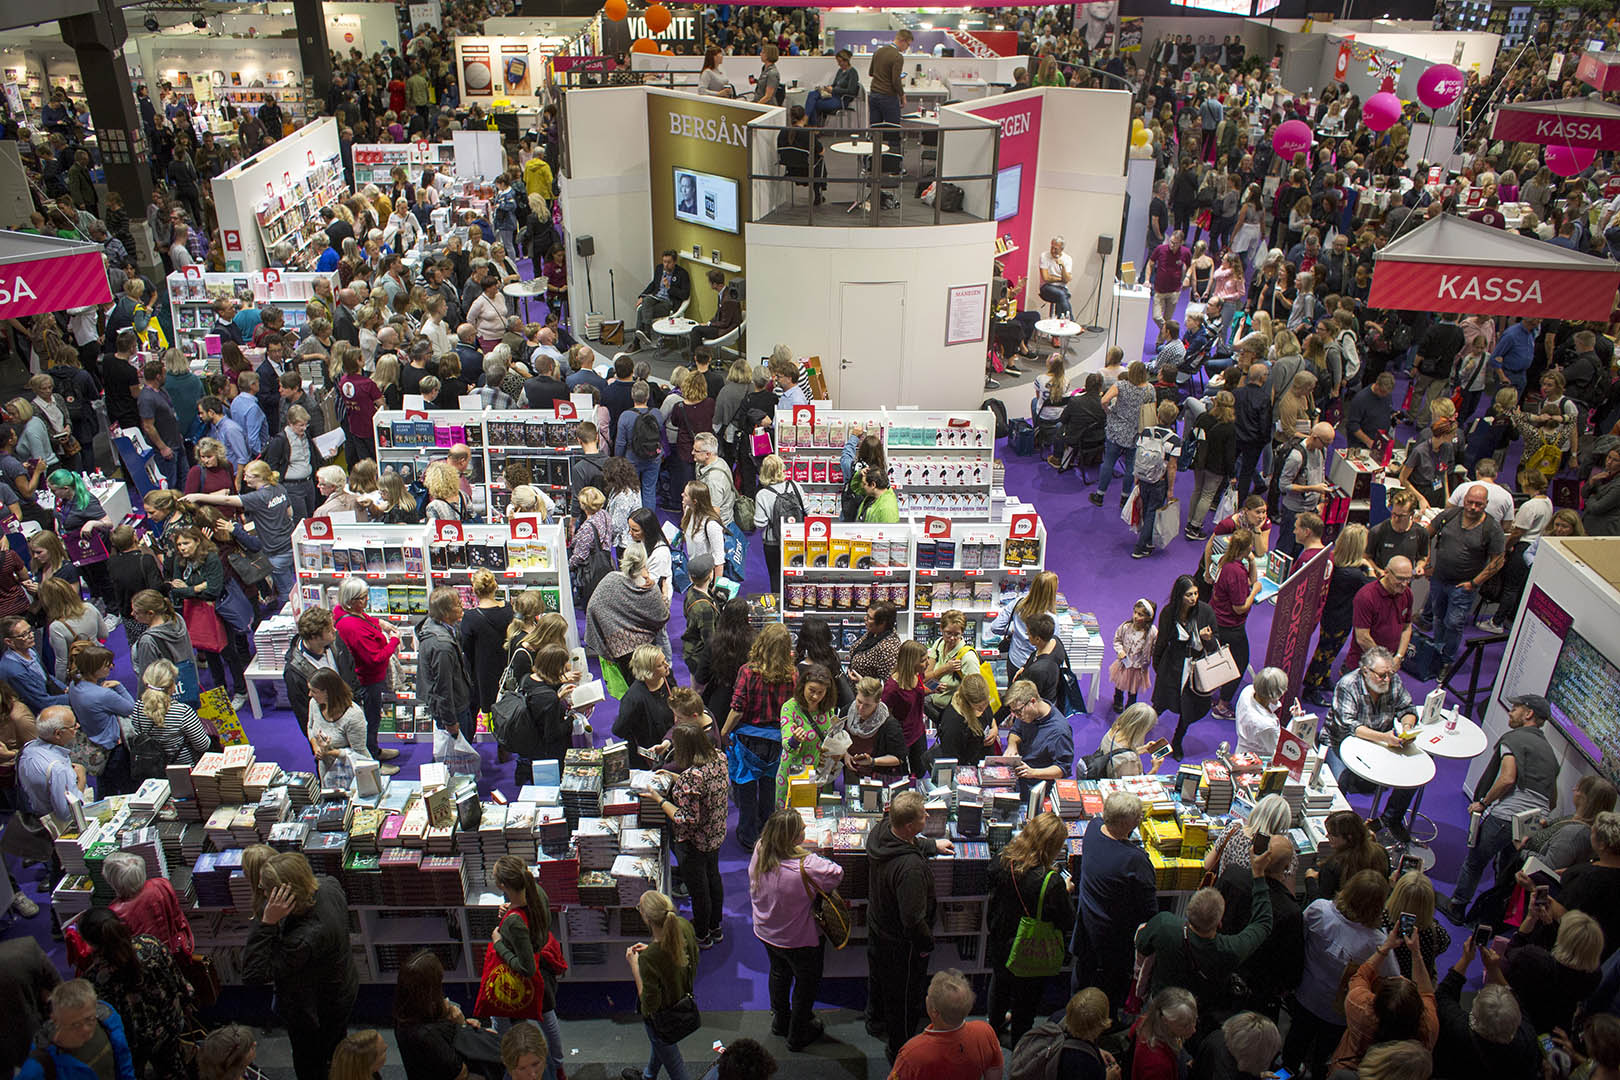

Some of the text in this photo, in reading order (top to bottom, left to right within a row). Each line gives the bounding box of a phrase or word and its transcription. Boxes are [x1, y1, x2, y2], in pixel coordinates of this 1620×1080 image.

[1434, 80, 1446, 95] 4
[669, 111, 748, 148] BERSÅN
[1536, 119, 1602, 141] KASSA
[1438, 274, 1543, 304] KASSA
